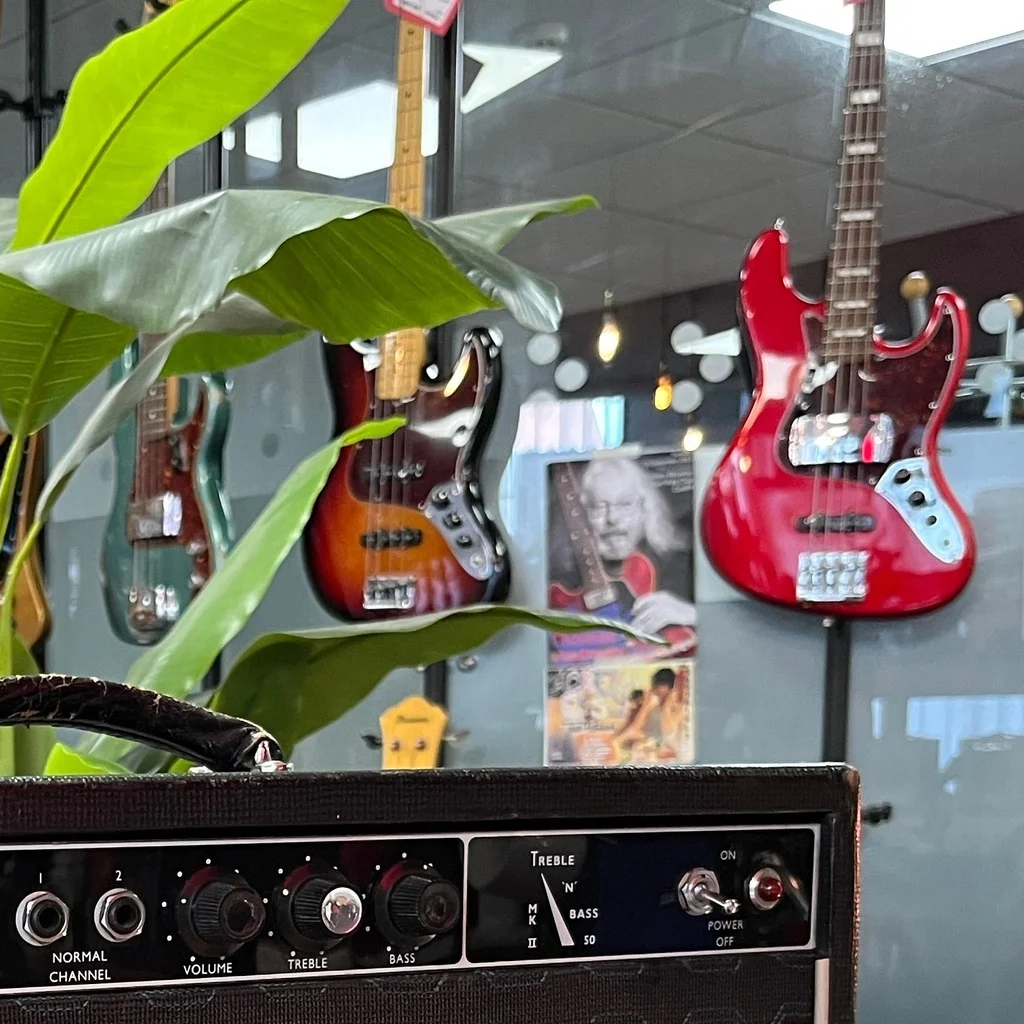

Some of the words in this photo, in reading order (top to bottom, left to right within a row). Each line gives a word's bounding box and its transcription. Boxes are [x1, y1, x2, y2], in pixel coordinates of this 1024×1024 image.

[530, 850, 576, 867] TREBLE
[720, 850, 737, 861] ON
[115, 870, 123, 882] 2
[569, 908, 600, 920] BASS
[707, 919, 744, 931] POWER
[583, 934, 596, 946] 50
[715, 936, 734, 947] OFF
[52, 951, 108, 964] NORMAL
[389, 953, 416, 965] BASS
[183, 962, 234, 976] VOLUME
[288, 958, 329, 971] TREBLE
[49, 969, 112, 984] CHANNEL
